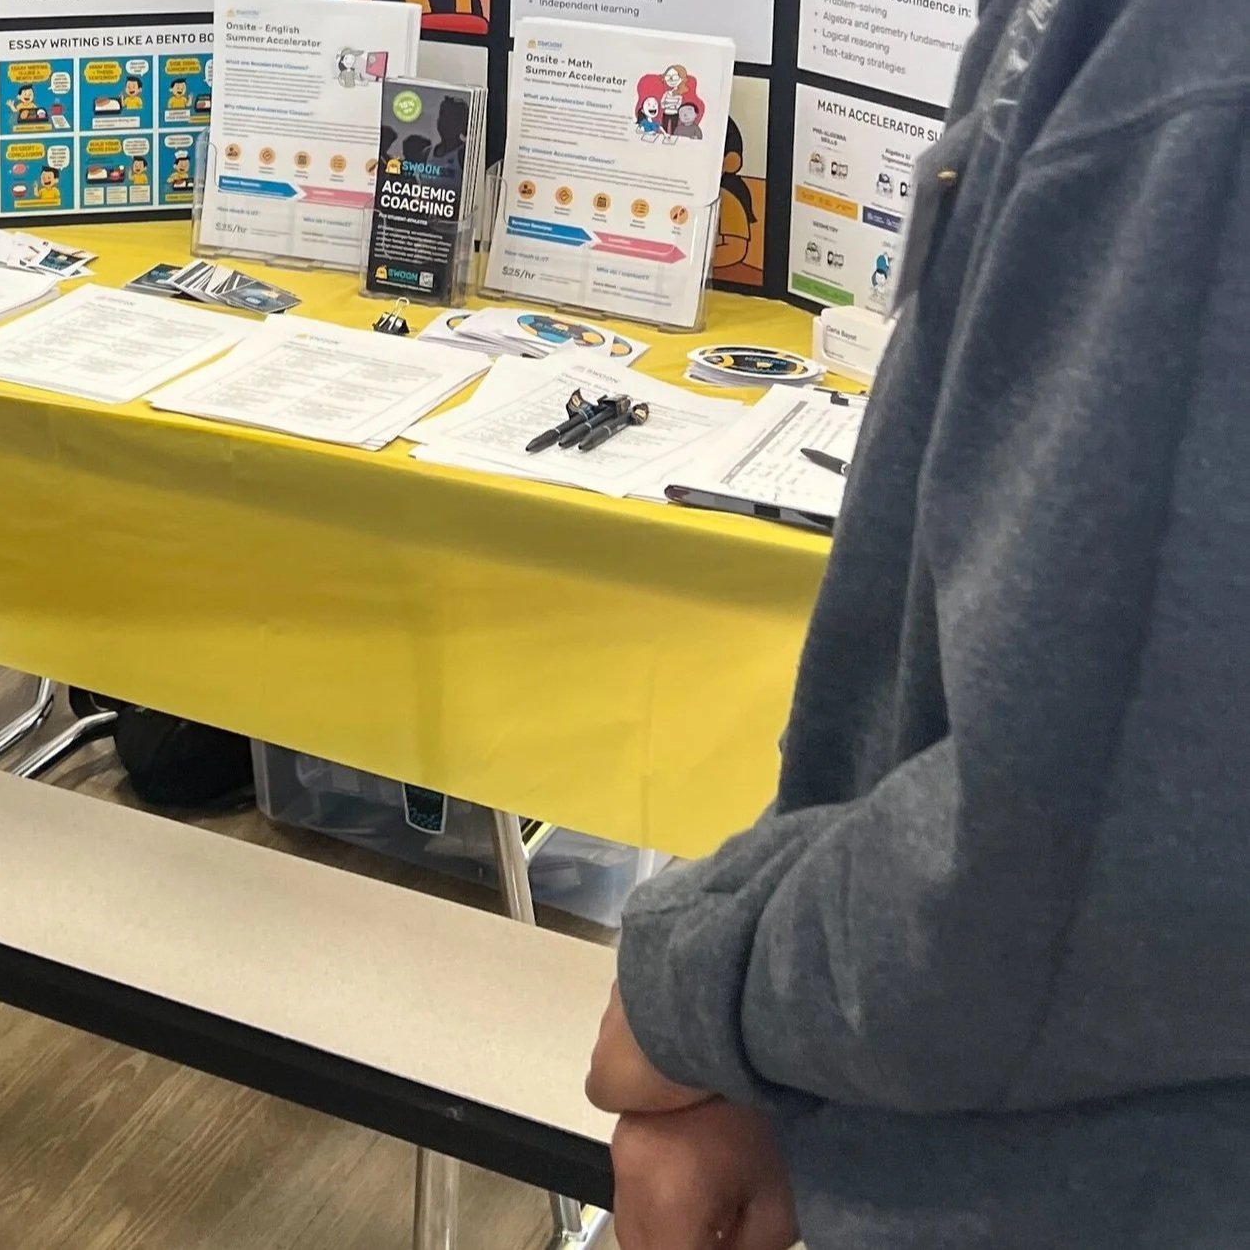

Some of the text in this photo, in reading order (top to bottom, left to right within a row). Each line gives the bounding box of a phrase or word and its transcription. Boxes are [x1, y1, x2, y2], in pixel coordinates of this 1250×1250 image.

[601, 4, 639, 17] learning
[958, 5, 971, 18] in:
[226, 22, 300, 35] Onsite English
[823, 12, 853, 26] Algebra
[854, 18, 869, 30] and
[870, 22, 908, 41] geometry
[9, 33, 214, 50] ESSAY WRITING IS LIKE A BENTO BO
[226, 33, 322, 47] Summer Accelerator
[822, 29, 890, 54] Logical reasoning
[526, 53, 593, 69] Onsite Math
[821, 44, 906, 75] Test-taking strategies
[525, 65, 566, 78] Summer
[568, 70, 627, 86] Accelerator
[817, 99, 846, 117] MATH
[848, 108, 925, 139] ACCELERATOR
[402, 161, 440, 175] SWOON
[382, 180, 456, 203] ACADEMIC
[380, 195, 454, 218] COACHING
